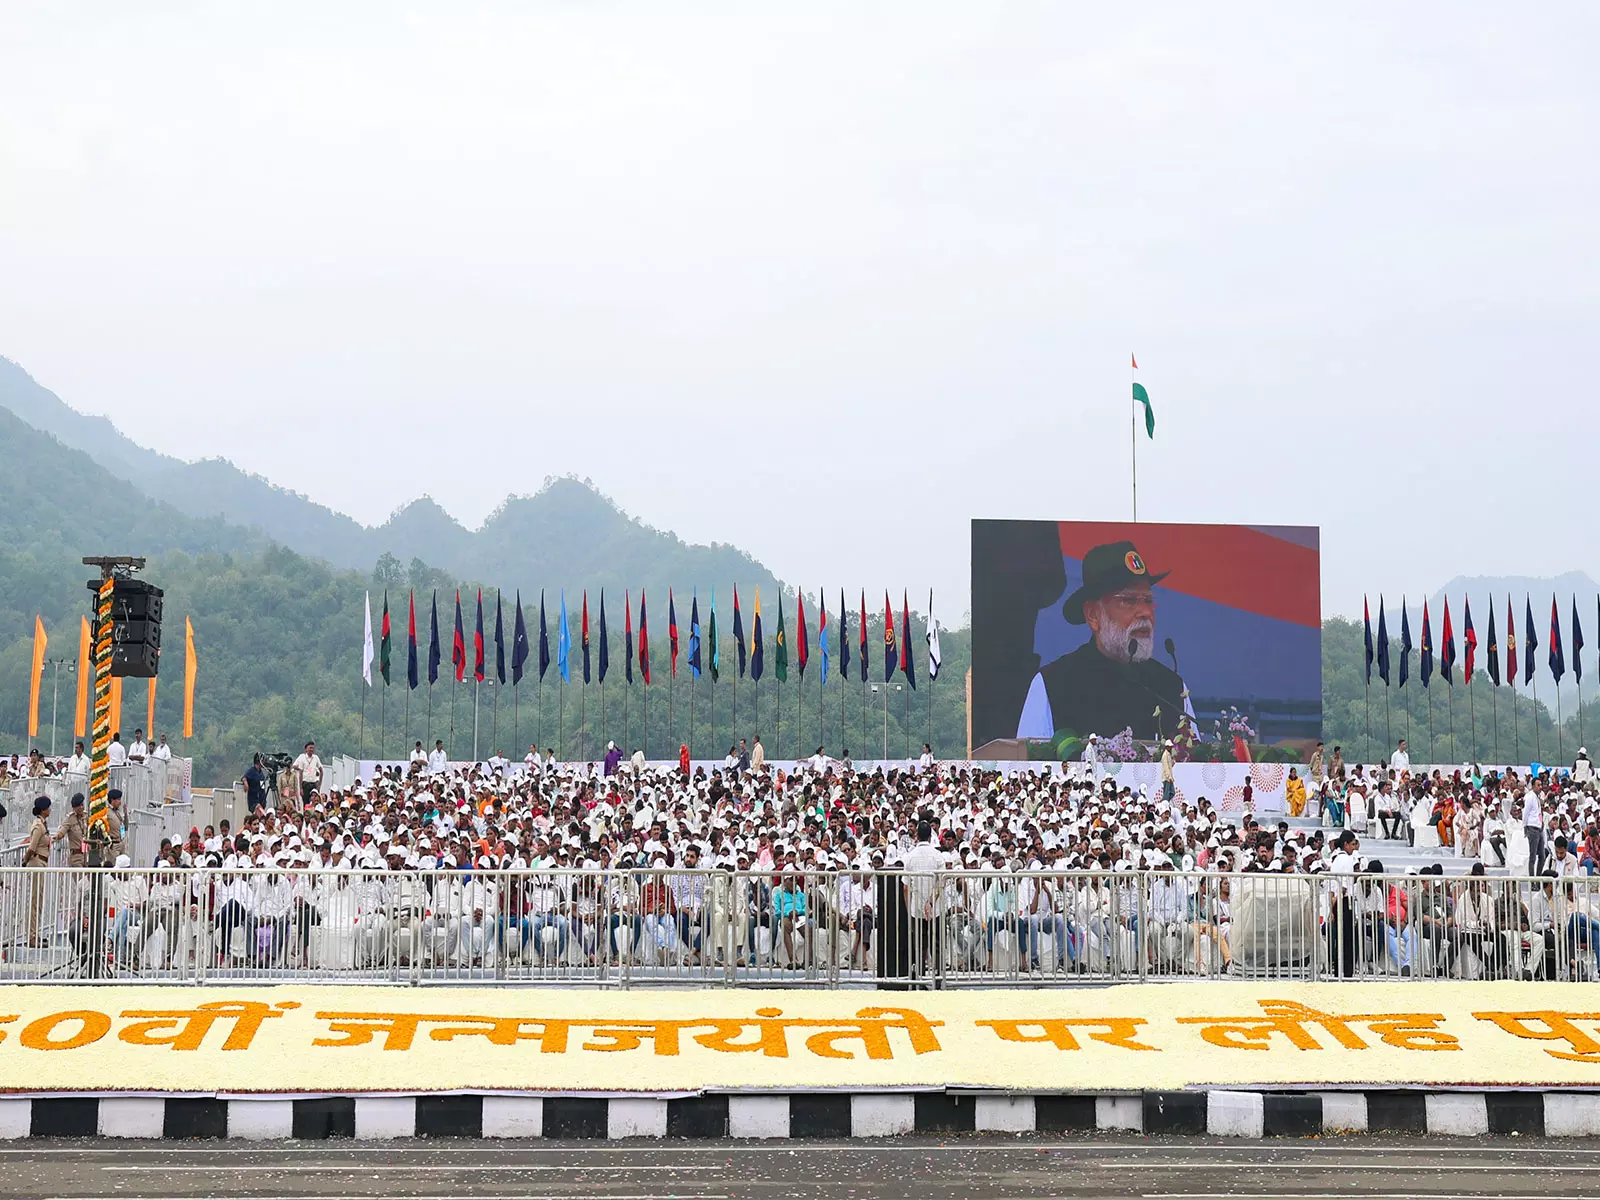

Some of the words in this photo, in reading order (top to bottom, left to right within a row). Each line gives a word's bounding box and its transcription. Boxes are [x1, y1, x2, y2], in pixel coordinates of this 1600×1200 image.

[0, 1001, 302, 1051] 0वीं
[312, 1006, 945, 1060] जन्मजयंती
[974, 1017, 1162, 1052] पर
[1176, 999, 1464, 1052] लौह
